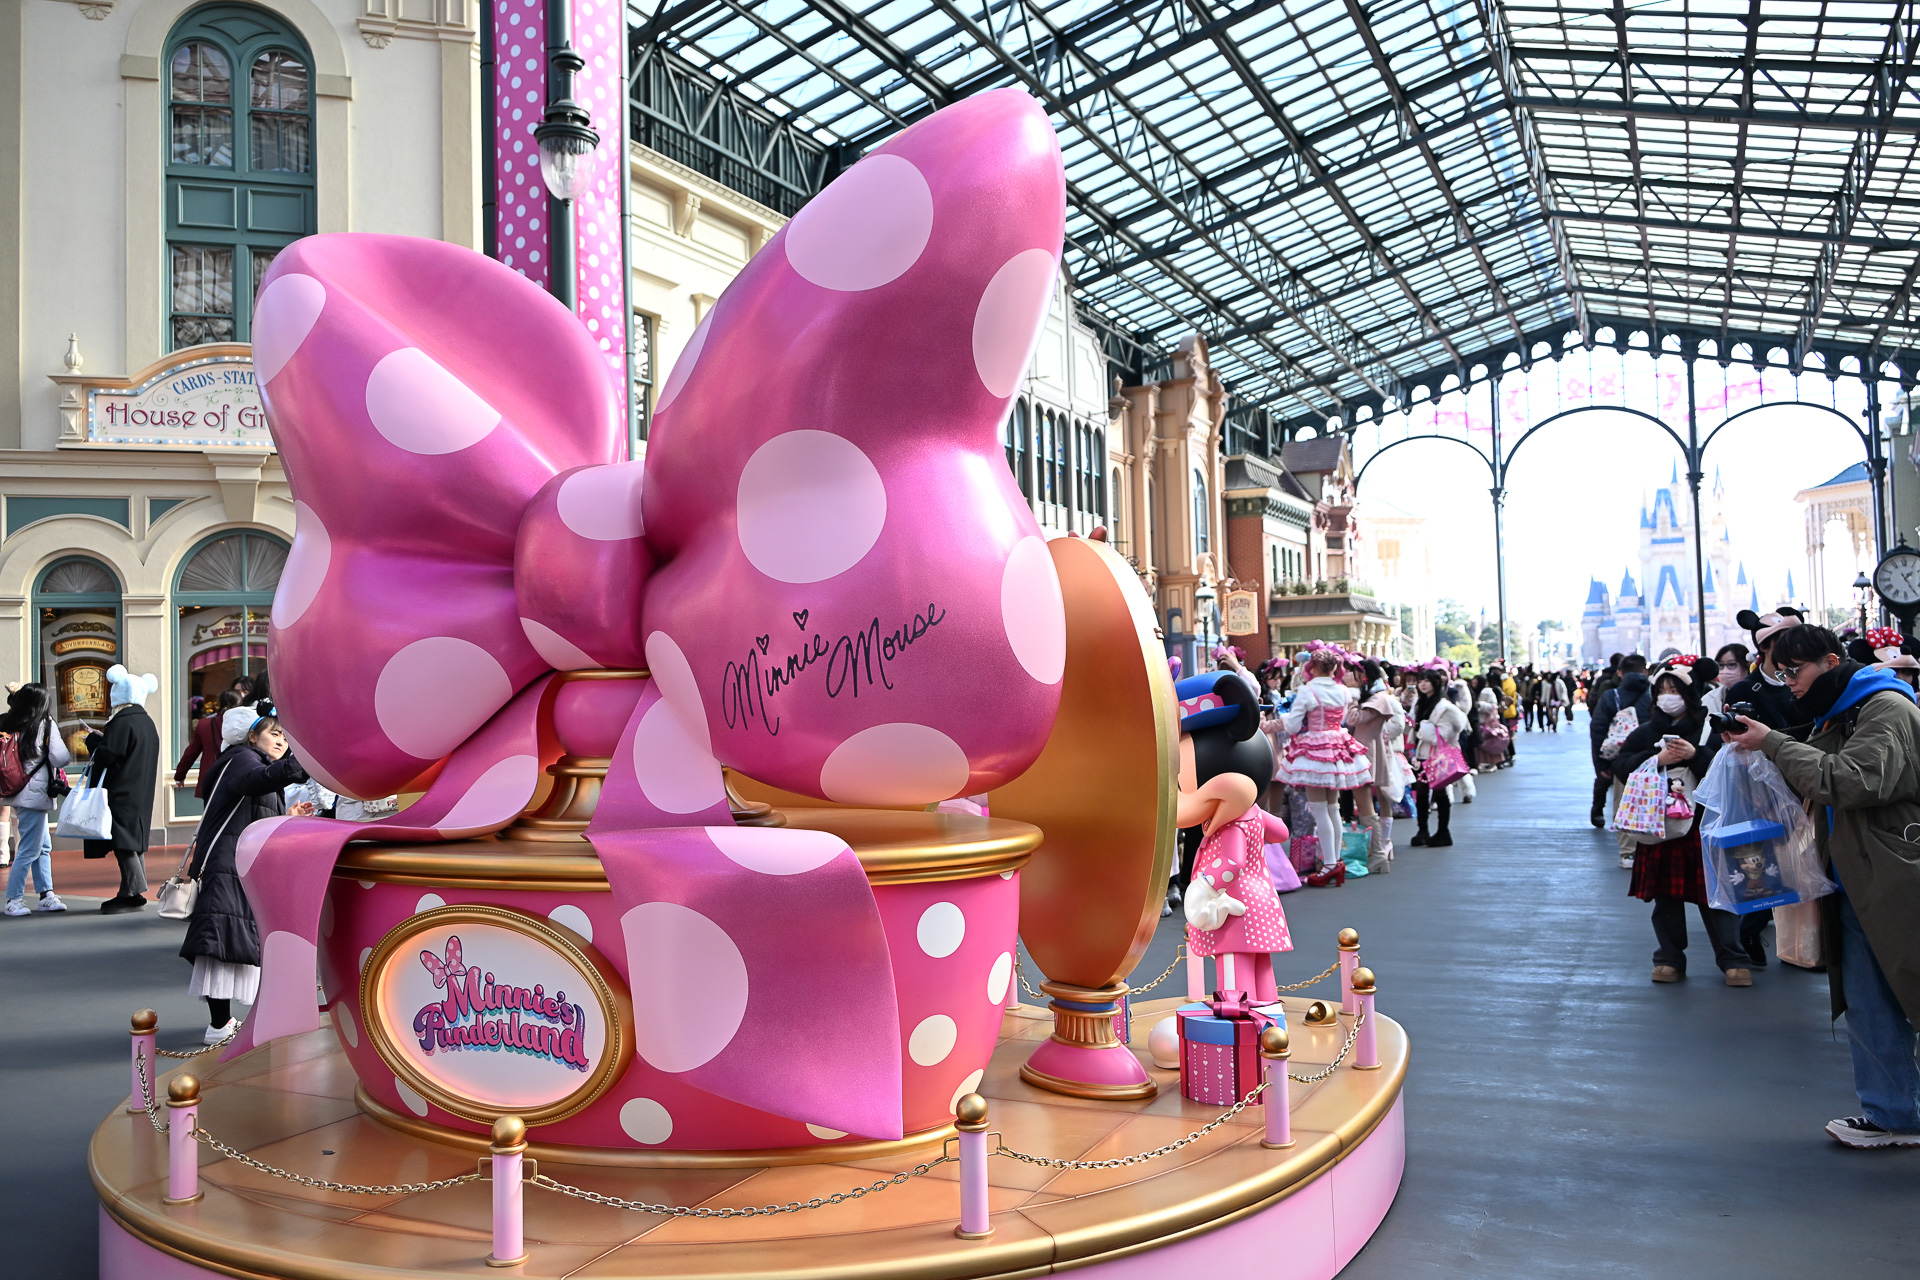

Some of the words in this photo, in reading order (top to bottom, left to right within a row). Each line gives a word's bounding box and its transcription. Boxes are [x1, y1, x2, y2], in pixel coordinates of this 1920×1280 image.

[106, 402, 197, 428] House
[204, 403, 230, 432] of
[1231, 621, 1252, 631] GIFTS
[722, 608, 830, 736] Minnie
[825, 602, 946, 698] Mouse
[442, 966, 575, 1026] Minnie's
[412, 1000, 590, 1073] Funderland
